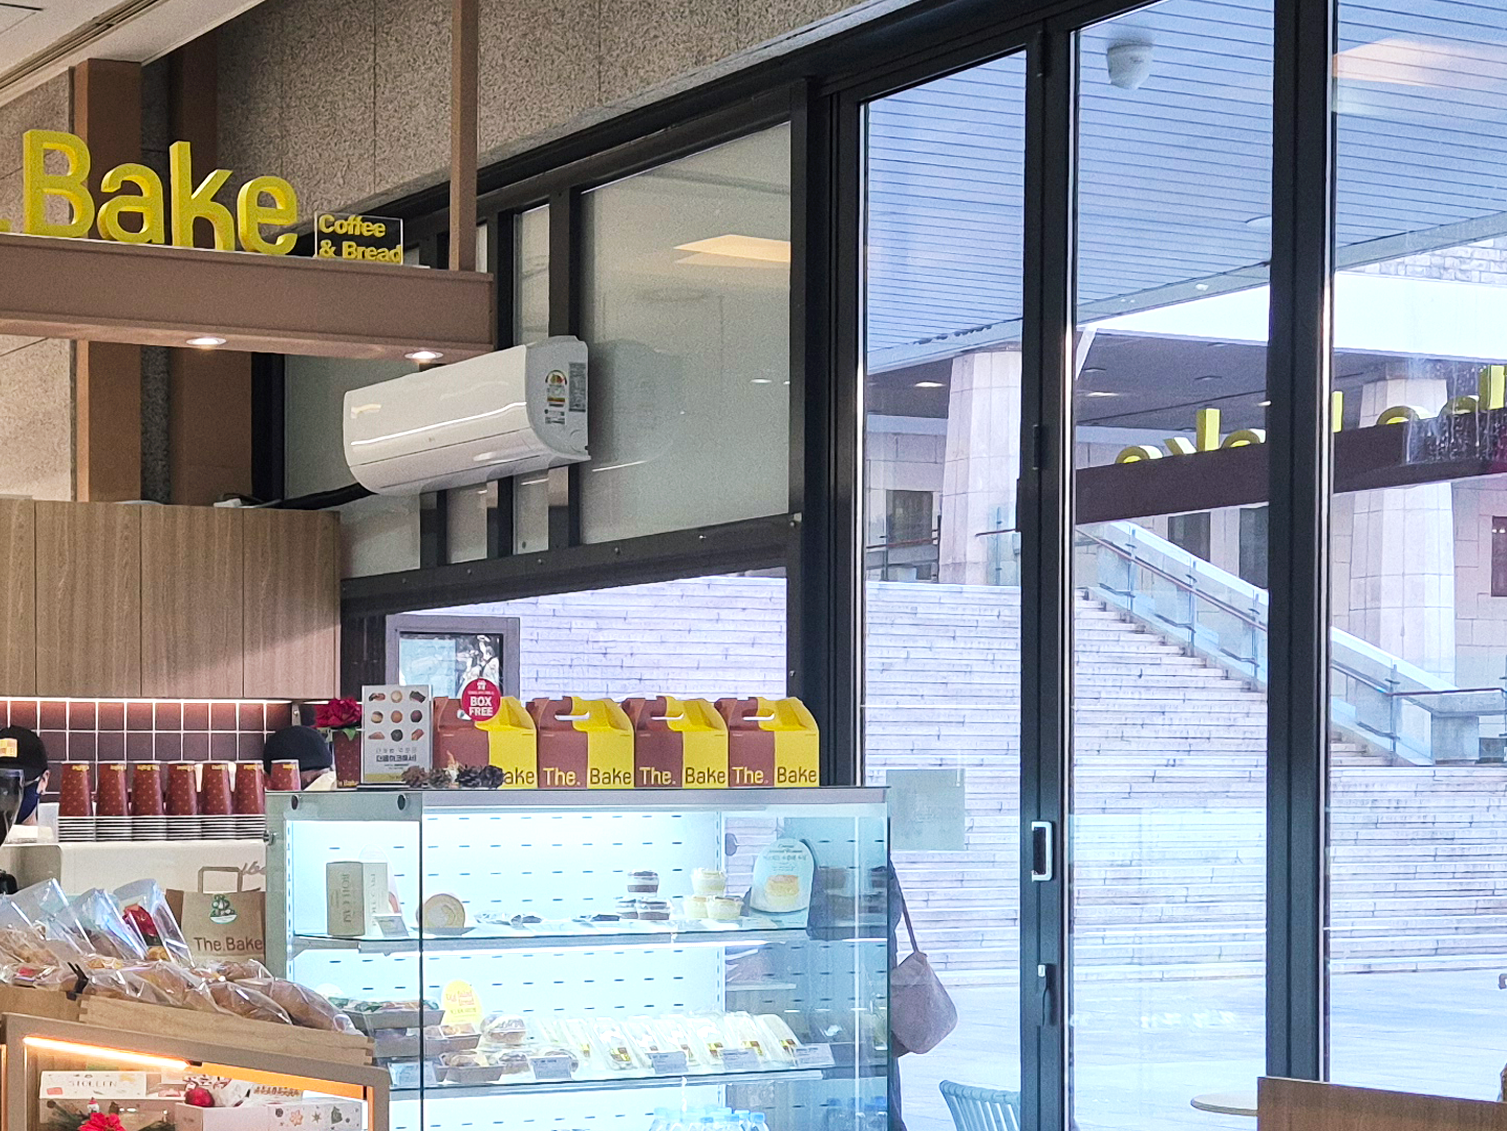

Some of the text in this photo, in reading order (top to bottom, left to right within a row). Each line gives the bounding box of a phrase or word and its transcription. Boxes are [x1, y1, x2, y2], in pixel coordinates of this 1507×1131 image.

[319, 214, 386, 237] Coffee
[319, 239, 402, 263] & Bread
[470, 696, 492, 706] BOX
[469, 707, 493, 716] FREE
[503, 767, 535, 785] ake
[589, 768, 632, 785] Bake
[685, 767, 726, 784] Bake
[777, 765, 817, 784] Bake
